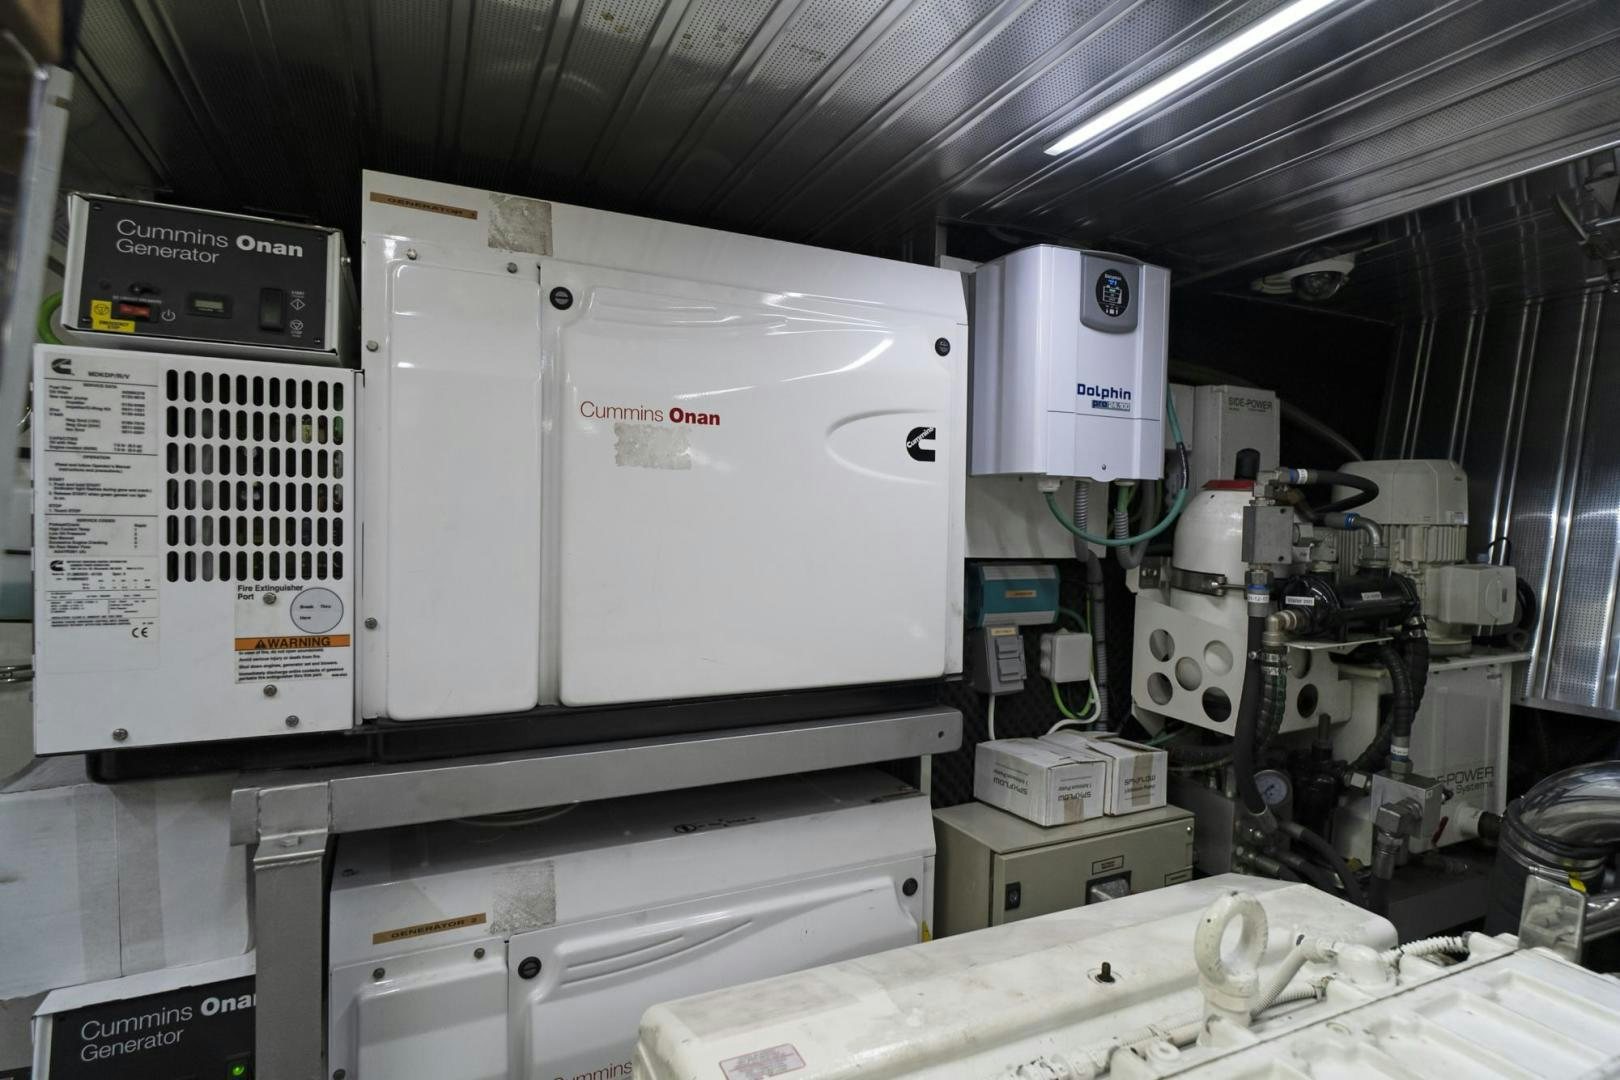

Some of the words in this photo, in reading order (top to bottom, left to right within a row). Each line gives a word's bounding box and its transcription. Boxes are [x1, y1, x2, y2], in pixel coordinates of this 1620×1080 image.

[117, 219, 229, 248] Cummins
[236, 234, 303, 257] Onan
[116, 238, 220, 264] Generator
[1077, 383, 1131, 400] Dolphin
[580, 400, 663, 422] Cummins
[669, 407, 720, 425] Onan
[1228, 397, 1272, 410] SIDE-POWER
[255, 584, 303, 593] Extinguisher
[267, 636, 331, 648] WARNING
[391, 919, 464, 938] GENERATOR
[81, 1006, 193, 1041] Cummins
[80, 1029, 184, 1062] Generator
